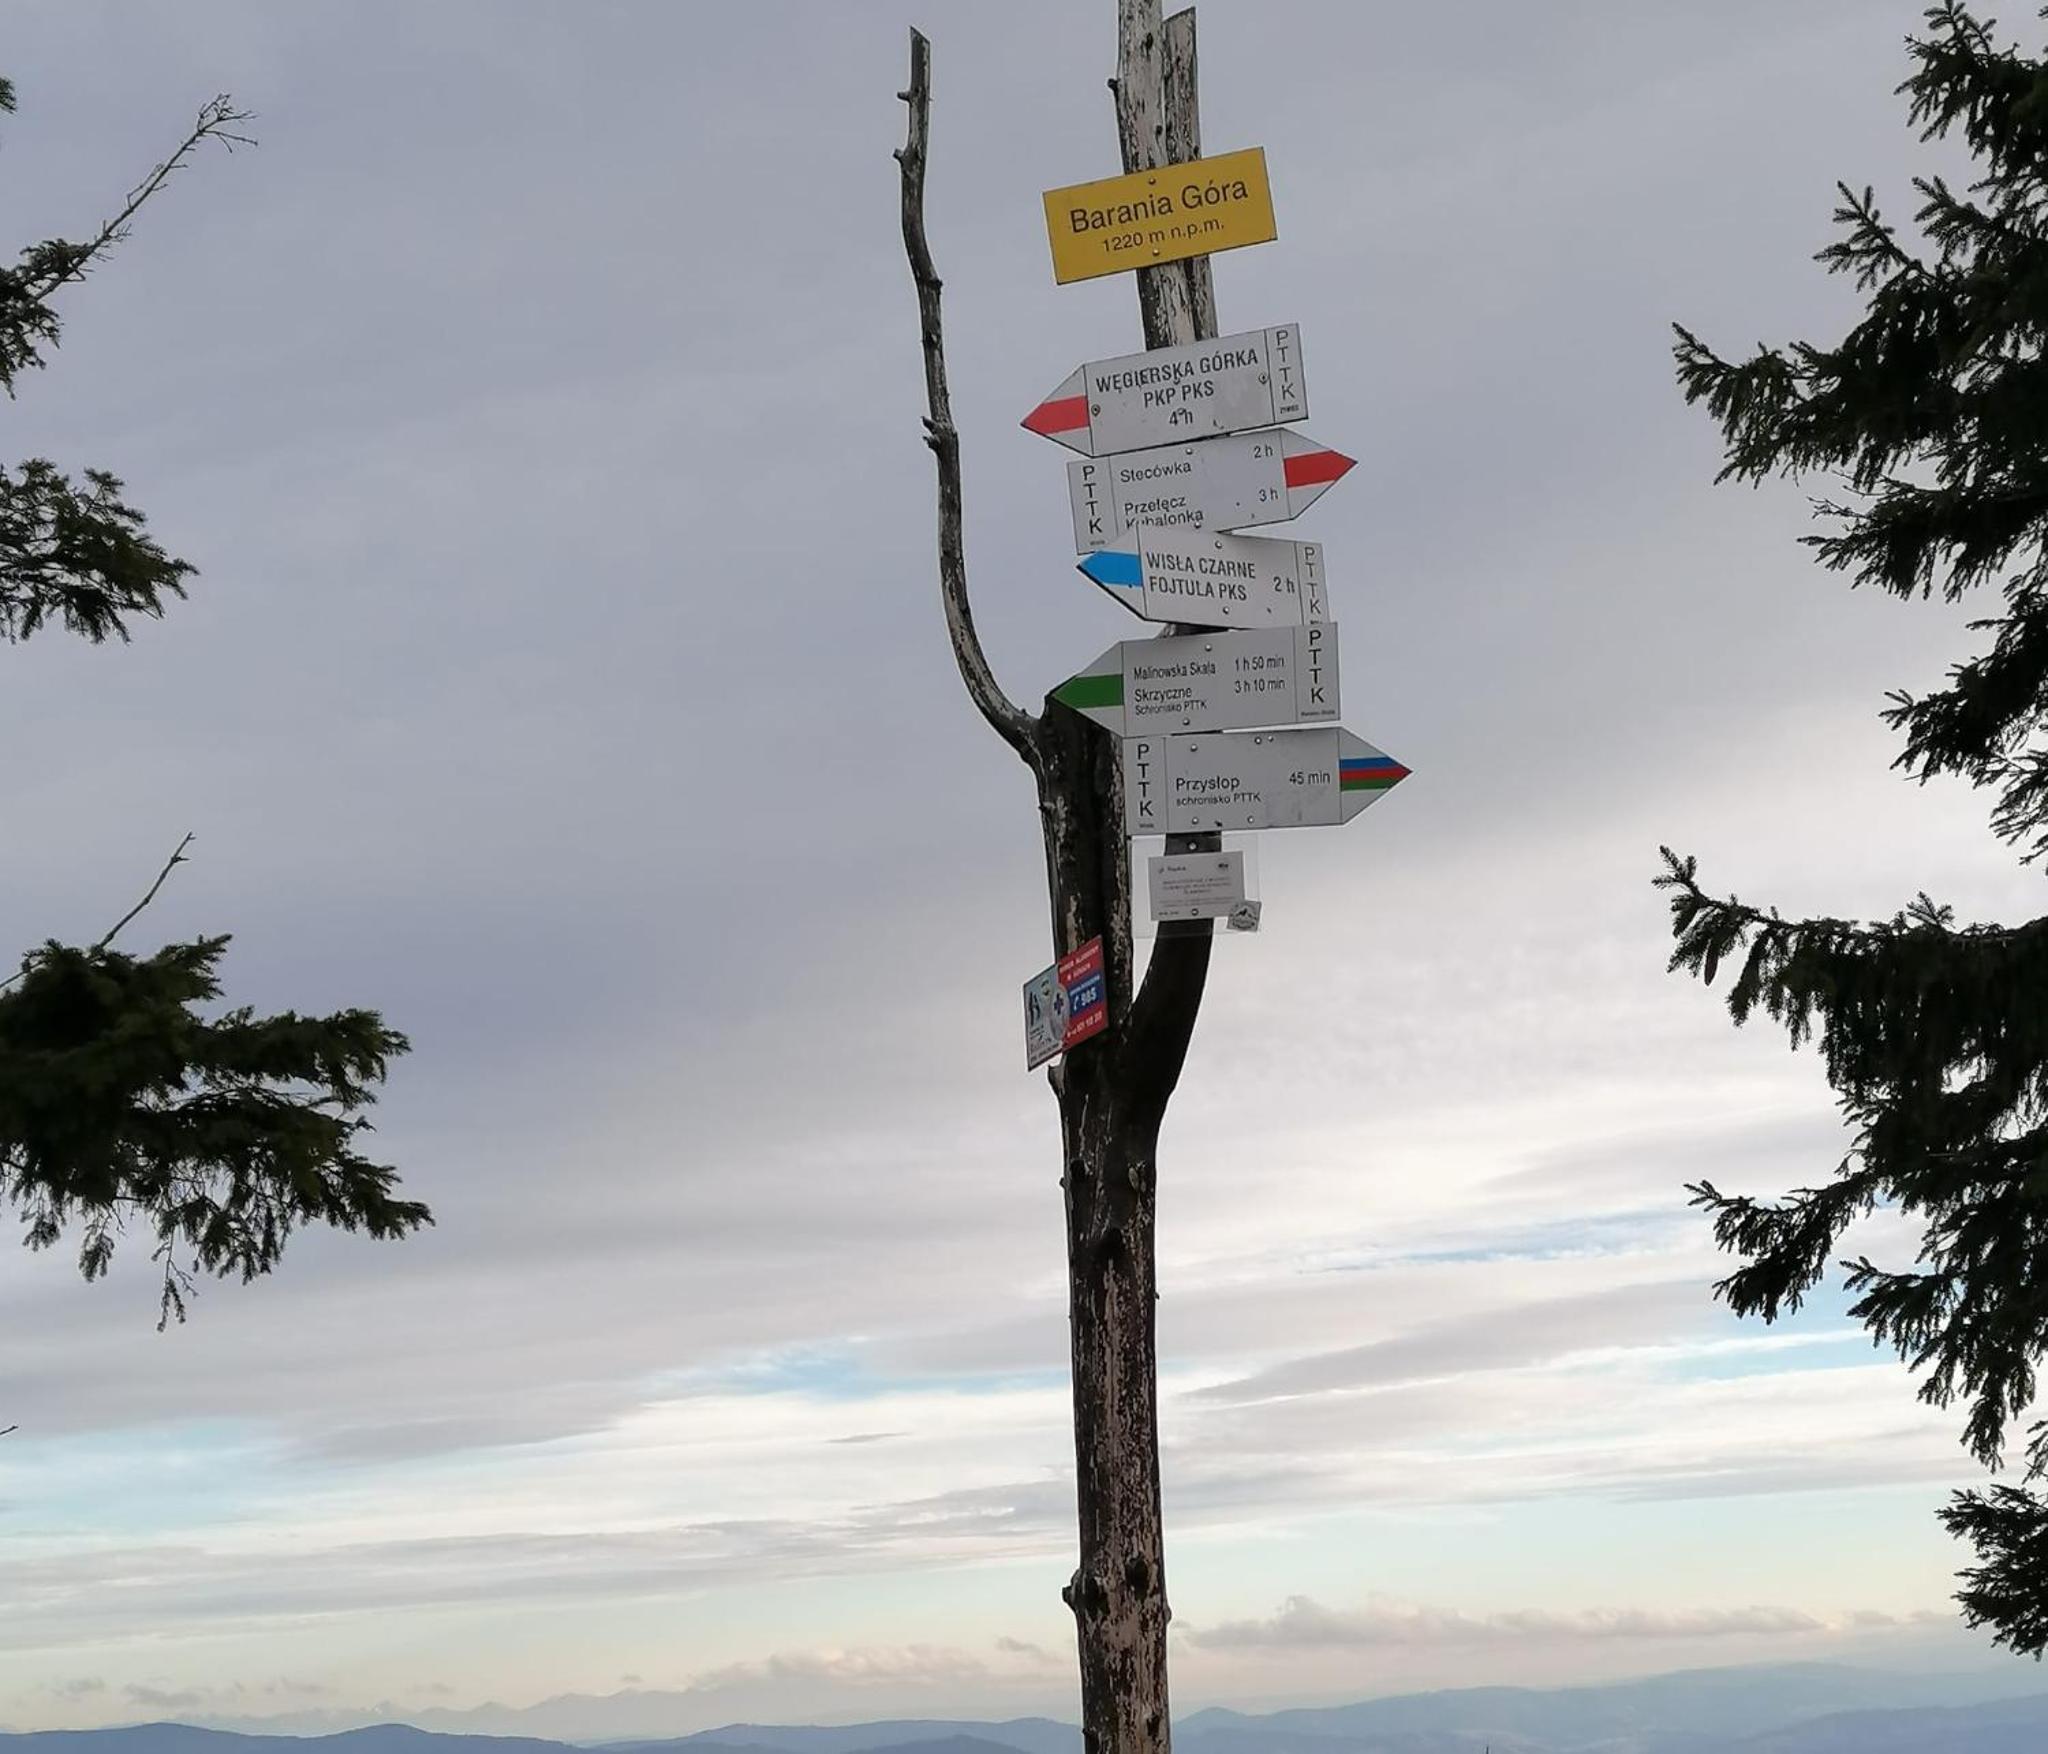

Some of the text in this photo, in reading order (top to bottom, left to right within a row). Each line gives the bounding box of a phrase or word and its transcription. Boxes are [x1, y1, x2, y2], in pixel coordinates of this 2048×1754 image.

[1070, 179, 1249, 234] Barania Góra
[1102, 220, 1225, 253] 1220 m n.p.m.
[1095, 347, 1259, 395] WĘGIERSKA GÓRKA
[1143, 380, 1215, 409] PKP PKS
[1168, 409, 1194, 427] 4 h
[1254, 445, 1274, 459] 2 h
[1120, 460, 1192, 484] Stecówka
[1258, 488, 1279, 502] 3 h
[1124, 495, 1187, 516] Przełęcz
[1146, 551, 1257, 580] WISŁA CZARNE
[1149, 575, 1247, 601] FOJTULA PKS
[1273, 576, 1295, 594] 2 h
[1133, 662, 1188, 681] Malinowska
[1234, 655, 1285, 671] 1 h 50 min
[1234, 677, 1286, 694] 3 h 10 min
[1133, 686, 1193, 704] Skrzyczne
[1184, 698, 1208, 712] PTTK
[1288, 770, 1331, 786] 45 min
[1175, 790, 1262, 807] schronisko PTTK
